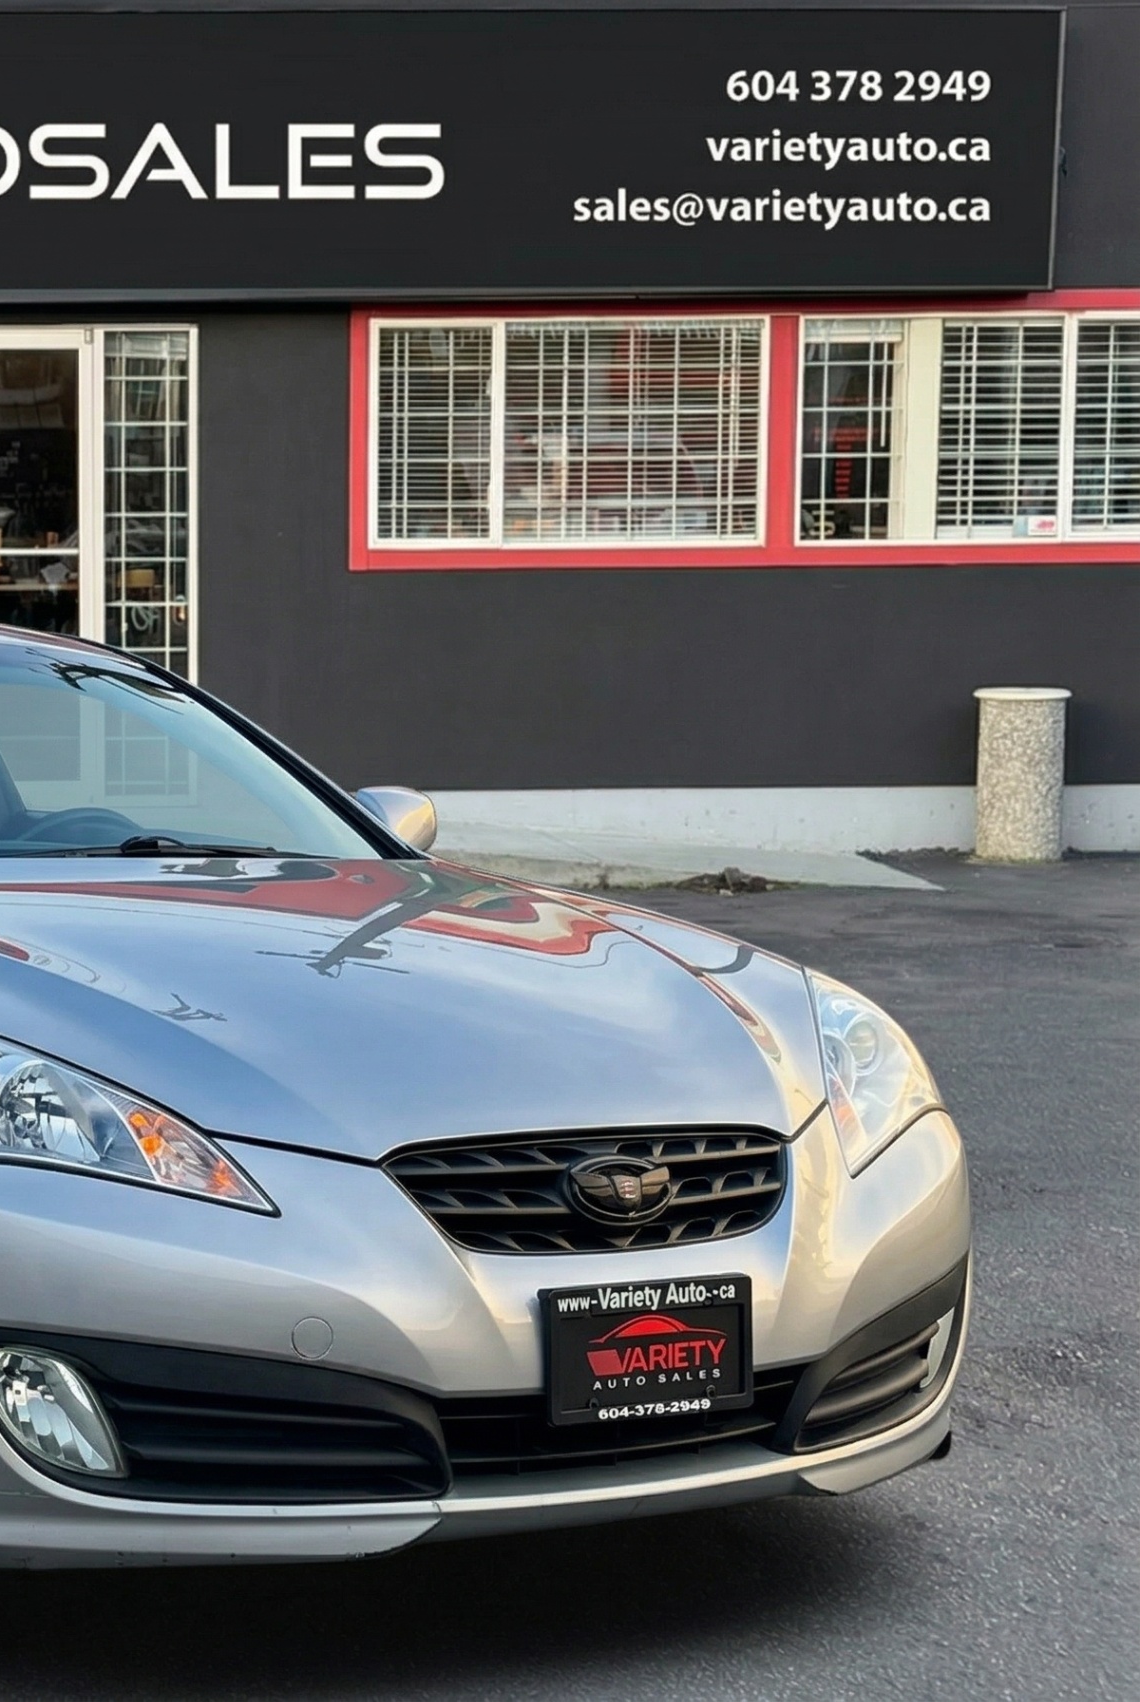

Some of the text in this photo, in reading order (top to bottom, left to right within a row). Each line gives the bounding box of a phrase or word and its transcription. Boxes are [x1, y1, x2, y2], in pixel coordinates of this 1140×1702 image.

[726, 70, 991, 102] 604 378 2949
[705, 128, 991, 170] varietyauto.ca
[573, 187, 991, 231] sales@varietyauto.ca
[587, 1338, 726, 1376] VARIETY
[593, 1368, 721, 1391] AUTO SALES
[598, 1398, 711, 1420] 604-378-2949
